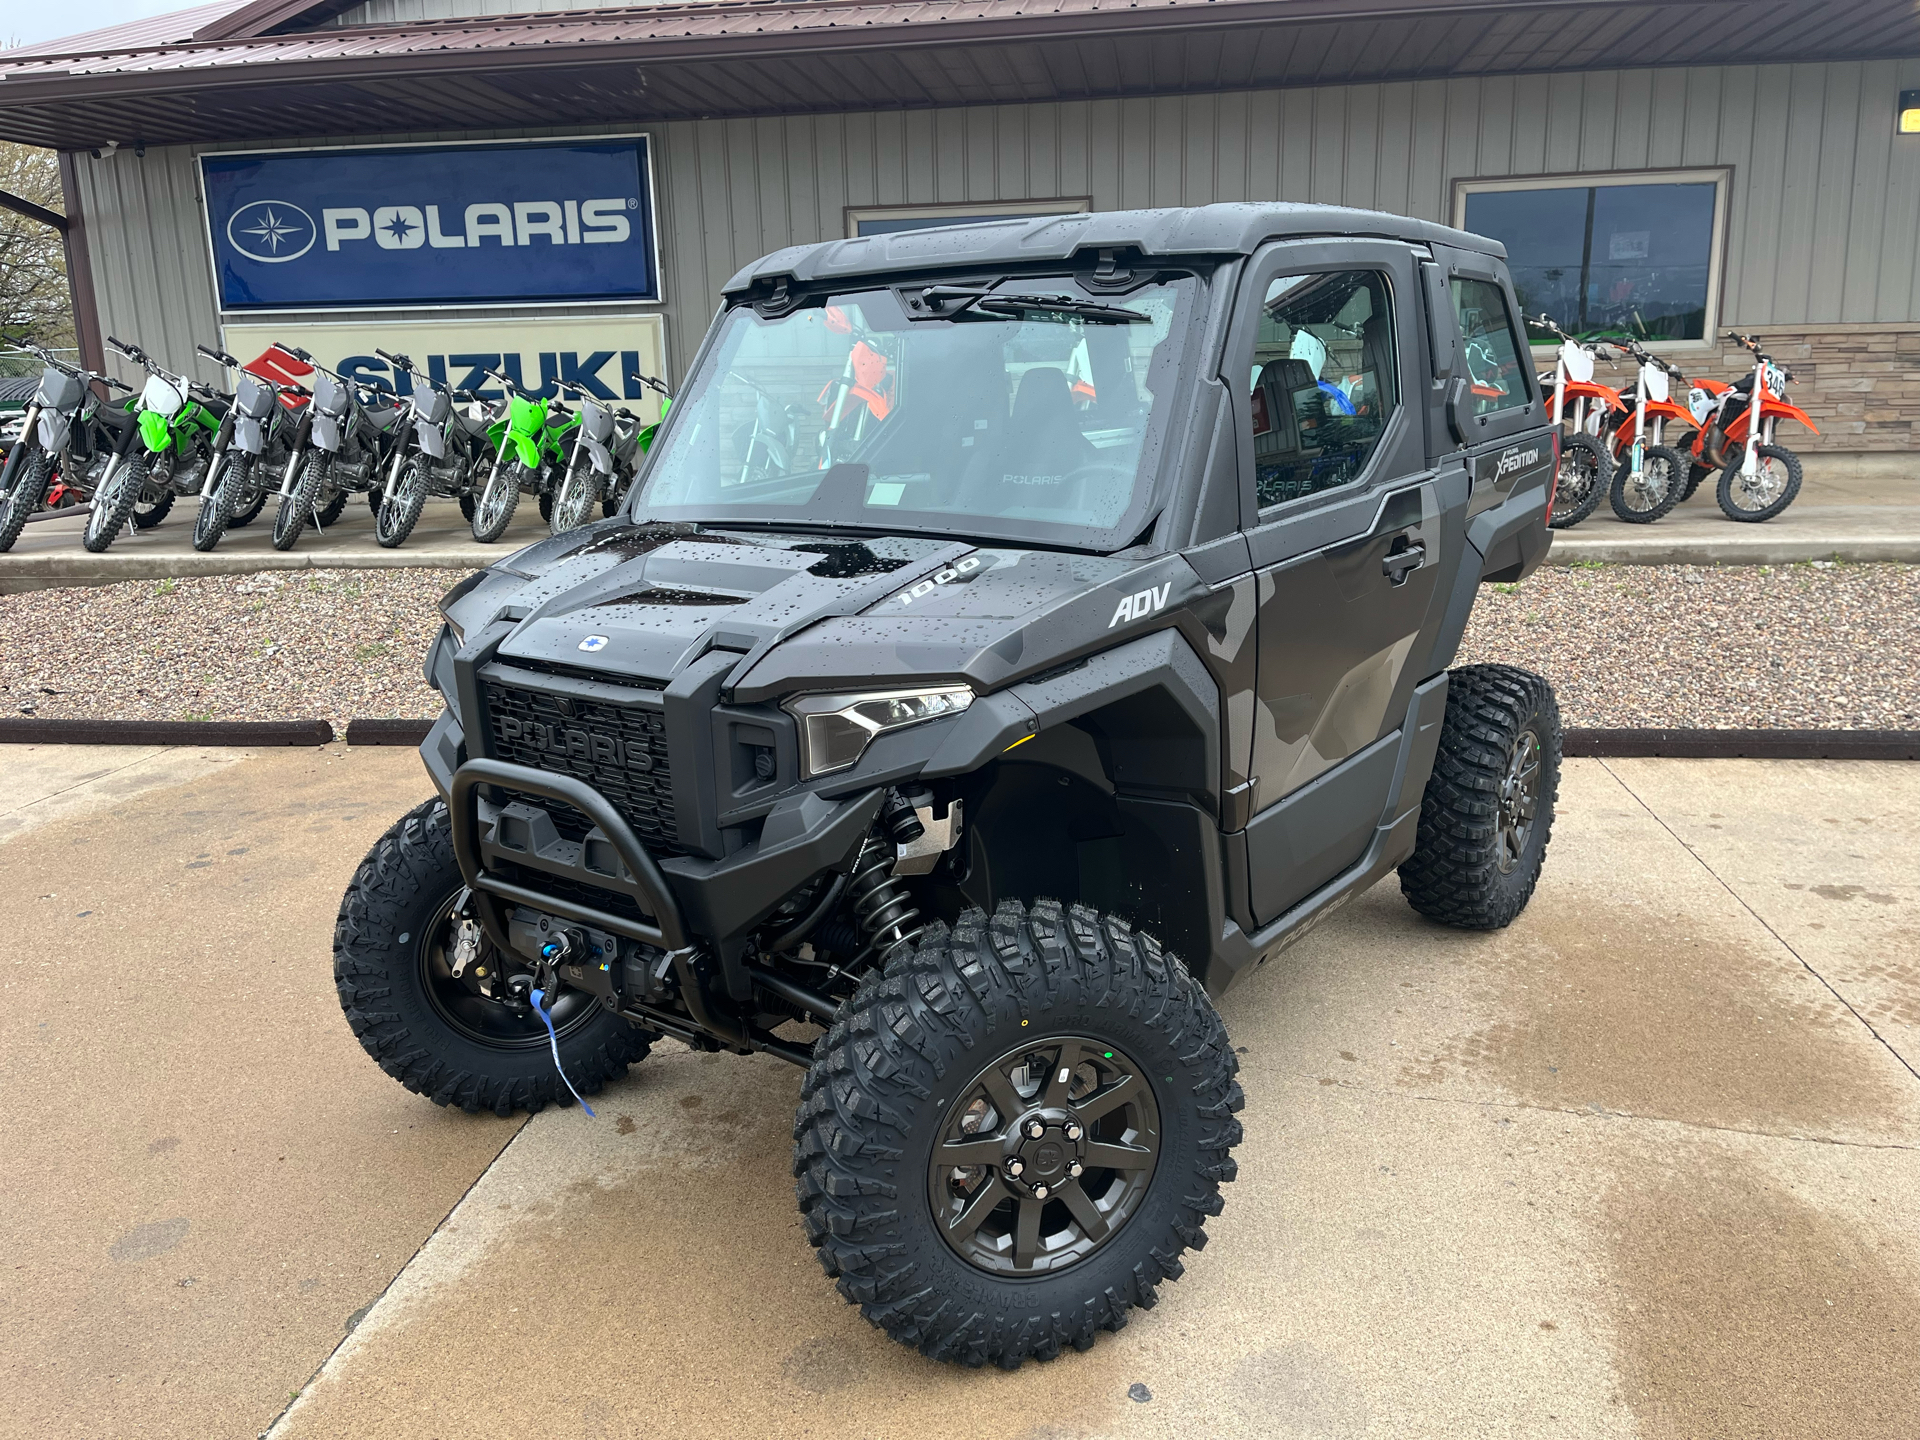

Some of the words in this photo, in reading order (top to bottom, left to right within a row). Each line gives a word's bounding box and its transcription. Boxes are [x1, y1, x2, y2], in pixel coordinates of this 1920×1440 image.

[322, 199, 631, 251] POLARIS
[336, 350, 642, 402] SUZUKI
[1494, 448, 1539, 483] XPEDITION
[897, 557, 981, 606] 1000
[1108, 581, 1172, 629] ADV
[500, 715, 653, 772] POLARIS
[1278, 888, 1354, 951] POLARIS
